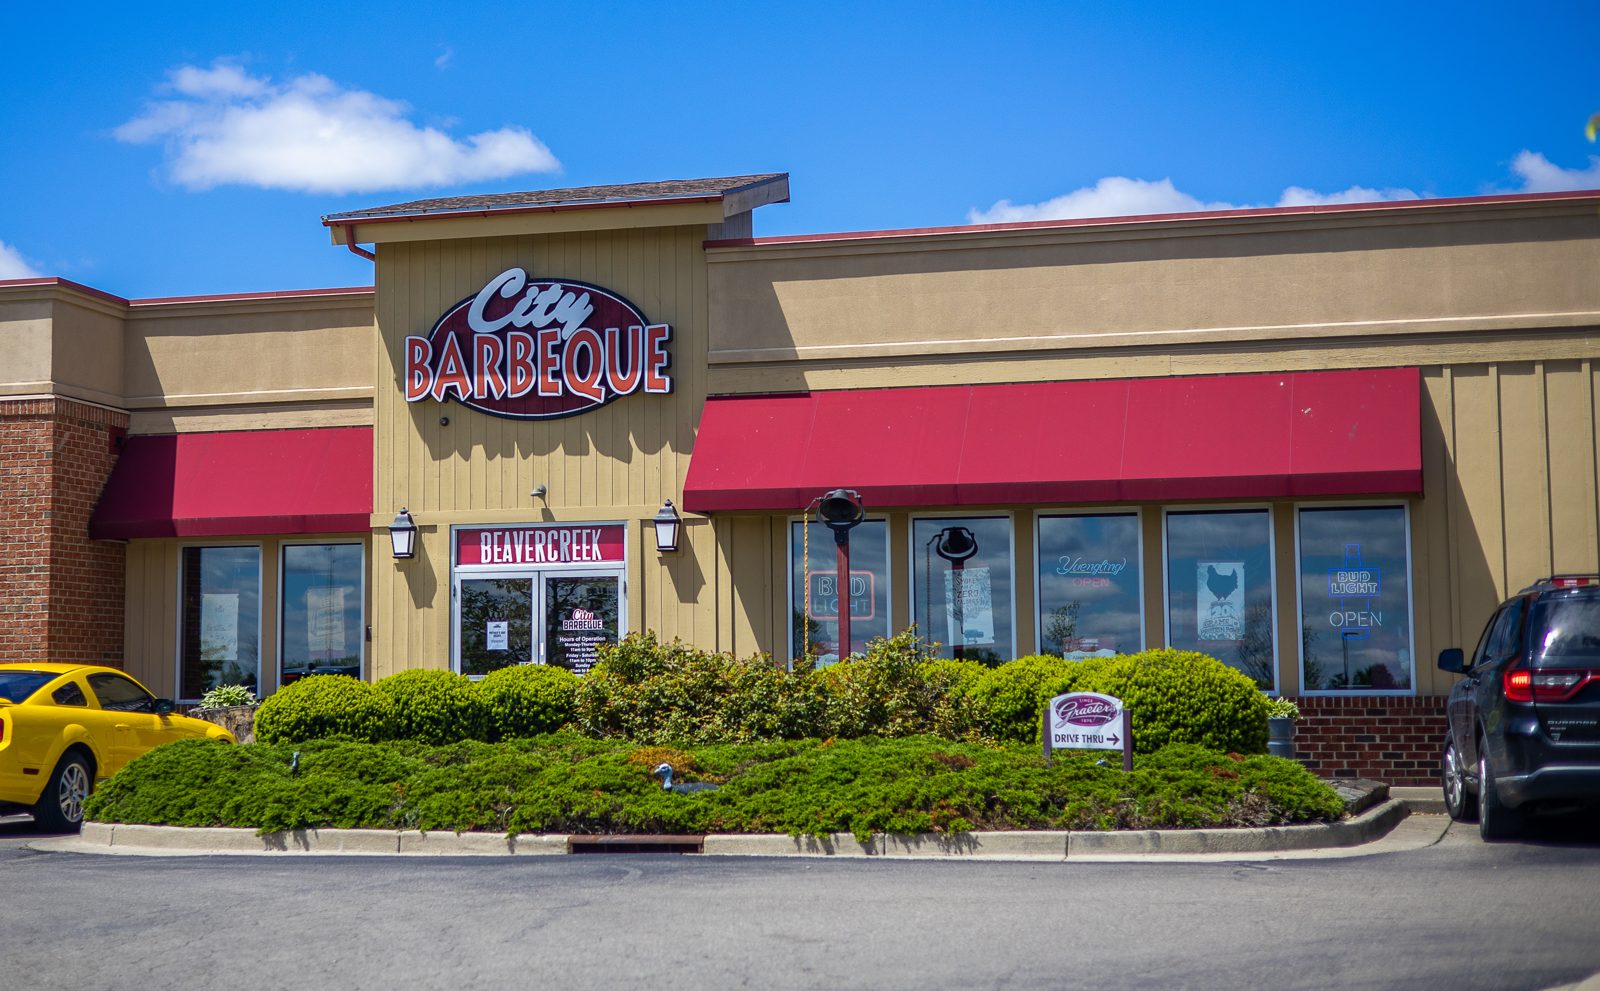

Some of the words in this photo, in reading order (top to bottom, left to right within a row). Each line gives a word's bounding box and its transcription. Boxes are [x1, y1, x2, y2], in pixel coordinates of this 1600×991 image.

[467, 266, 595, 341] City
[404, 323, 671, 405] BARBEQUE
[479, 528, 603, 564] BEAVERCREEK
[1056, 555, 1127, 576] Yuengling
[1072, 577, 1110, 588] OPEN
[1337, 571, 1371, 582] BUD
[818, 576, 866, 596] BD
[1331, 582, 1378, 594] LIGHT
[573, 608, 594, 621] City
[1329, 611, 1382, 627] OPEN
[581, 635, 606, 643] Operation
[1054, 733, 1080, 743] DRIVE
[1081, 734, 1104, 744] THRU
